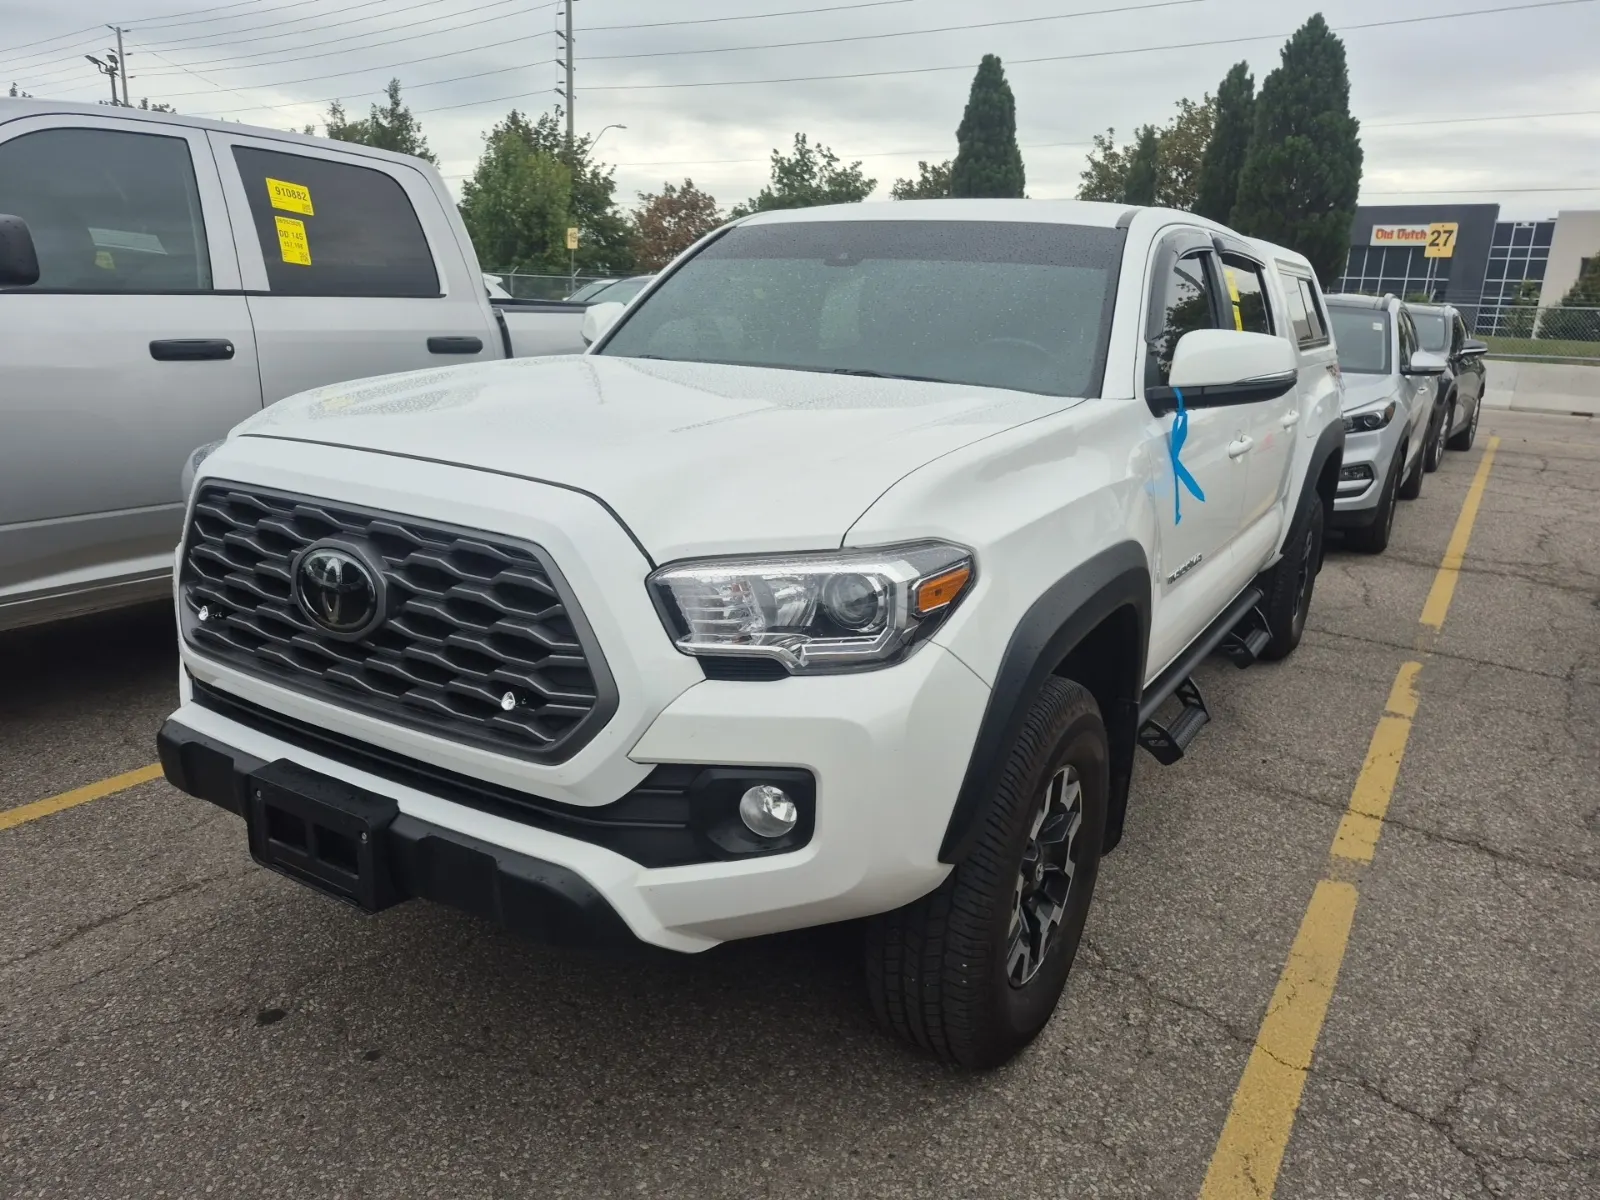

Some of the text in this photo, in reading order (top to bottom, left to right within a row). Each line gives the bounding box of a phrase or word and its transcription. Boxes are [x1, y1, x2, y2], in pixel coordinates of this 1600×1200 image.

[274, 186, 308, 202] 910882
[1375, 228, 1427, 240] Old Dutch
[1428, 229, 1454, 247] 27
